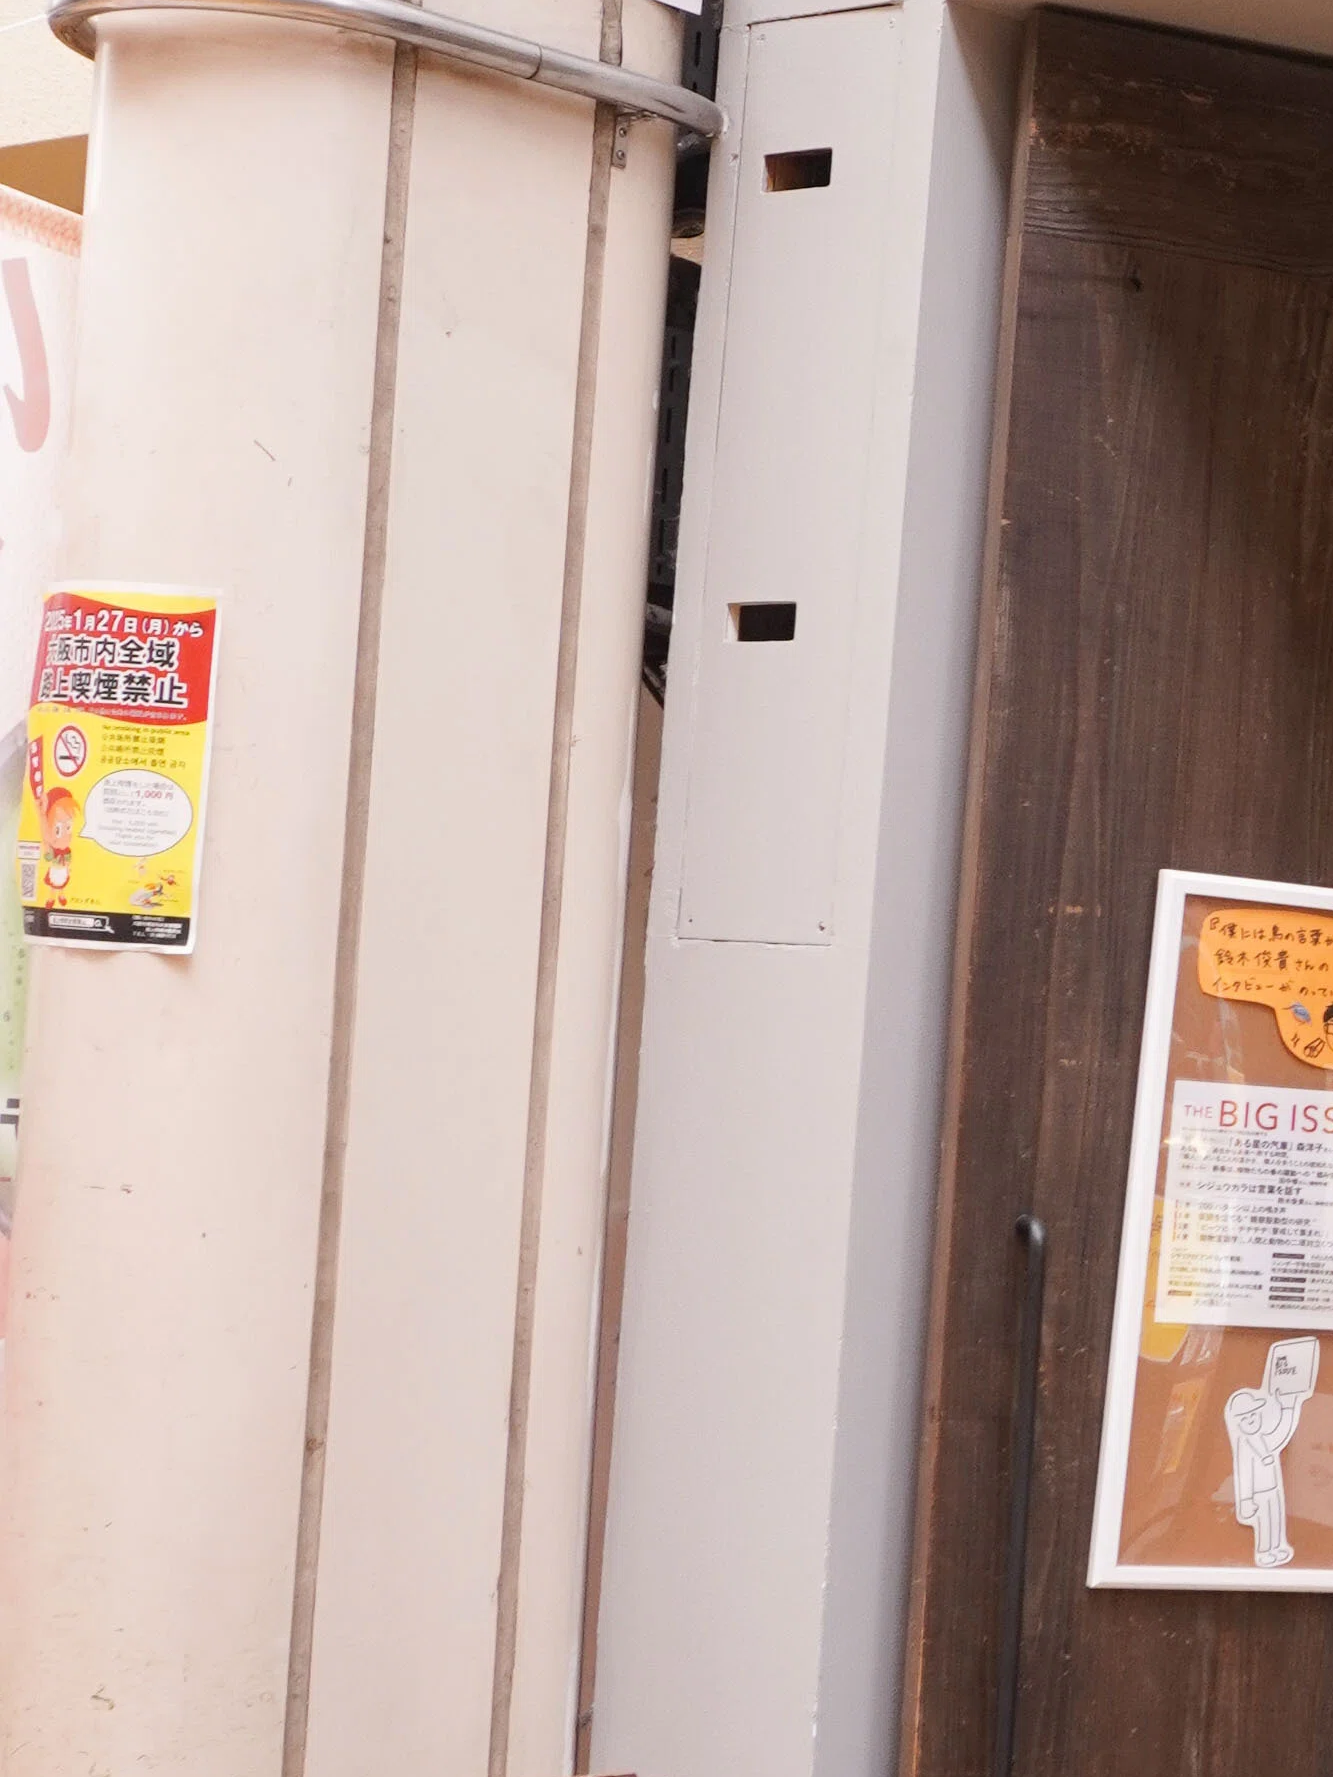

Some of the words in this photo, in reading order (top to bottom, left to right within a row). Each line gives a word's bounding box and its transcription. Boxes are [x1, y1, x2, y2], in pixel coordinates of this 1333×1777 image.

[41, 672, 185, 705] 路上喫煙禁止
[1184, 1104, 1213, 1119] THE
[1219, 1100, 1280, 1131] BIG
